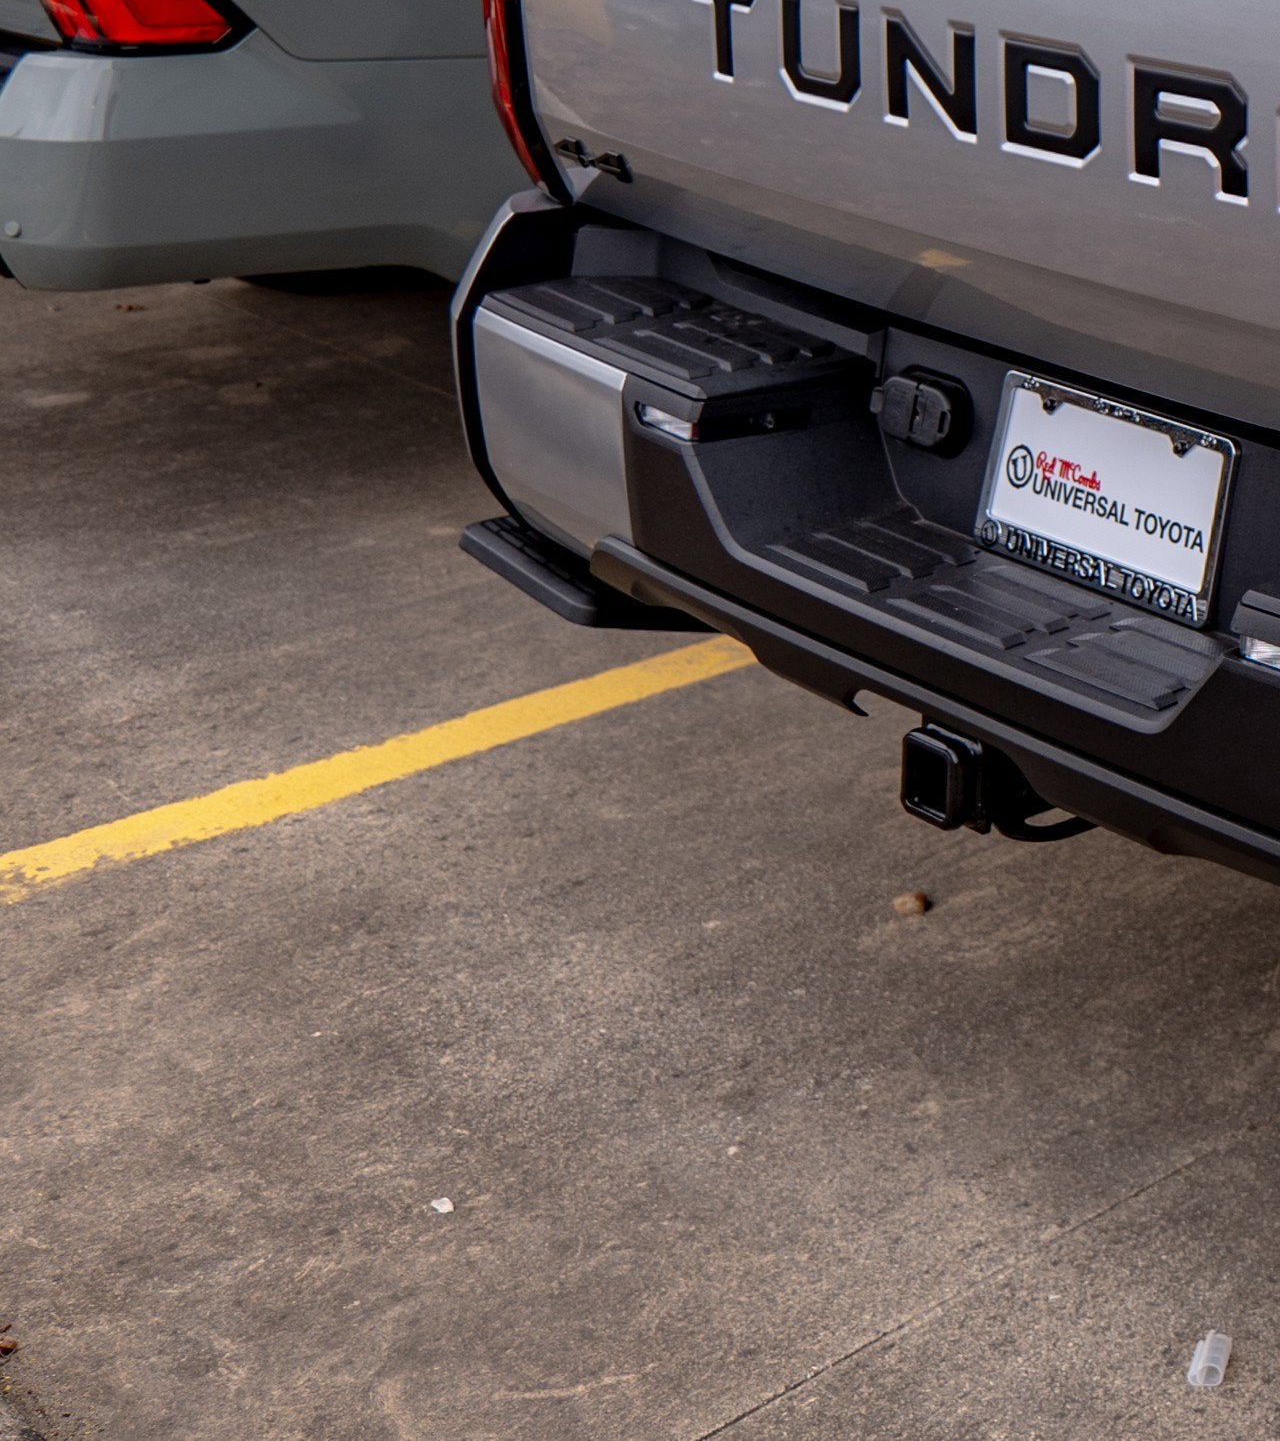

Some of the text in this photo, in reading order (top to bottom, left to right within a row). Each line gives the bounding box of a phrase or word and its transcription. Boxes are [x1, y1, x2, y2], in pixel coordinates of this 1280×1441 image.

[1036, 451, 1101, 491] Red McCombs
[1033, 474, 1204, 553] UNIVERSAL TOYOTA
[1006, 526, 1117, 591] UNIVERSAL
[1119, 569, 1199, 622] TOYOTA
